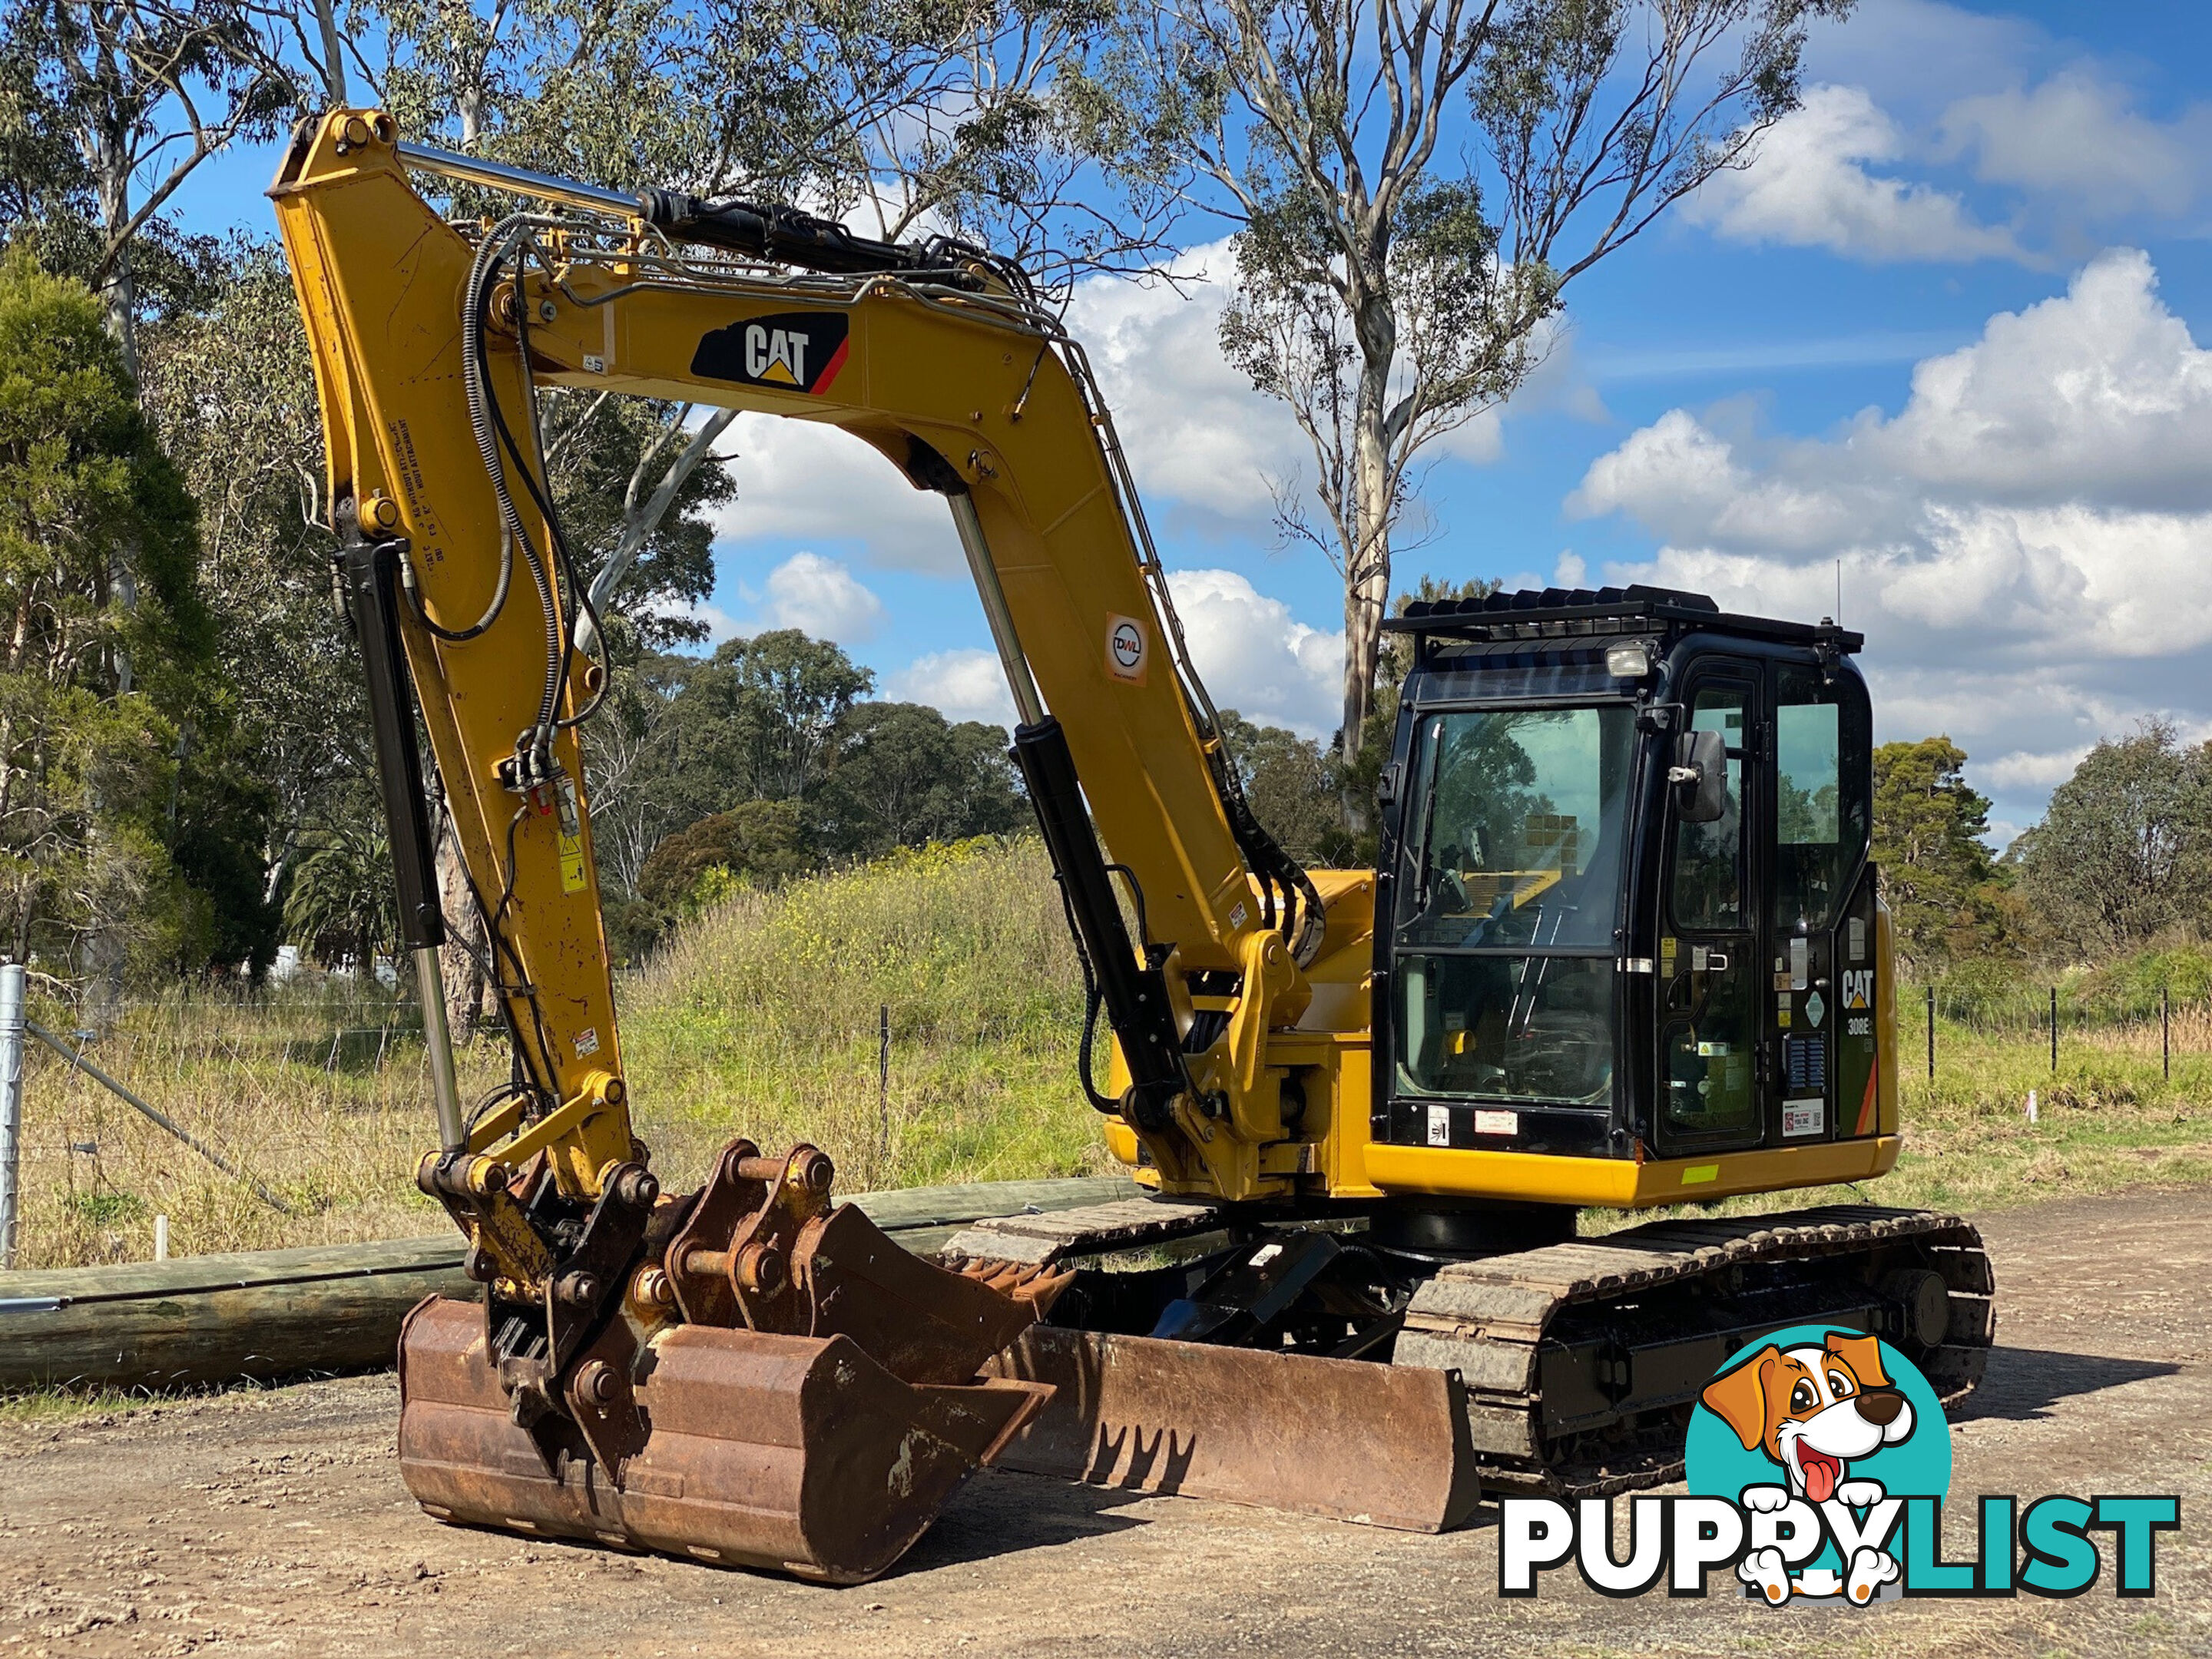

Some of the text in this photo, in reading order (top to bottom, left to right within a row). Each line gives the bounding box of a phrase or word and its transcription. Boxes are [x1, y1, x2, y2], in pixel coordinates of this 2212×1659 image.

[746, 324, 809, 386] CAT
[398, 419, 419, 469] ATTACHMENT
[1114, 637, 1139, 654] DWL
[1843, 969, 1873, 1008] CAT
